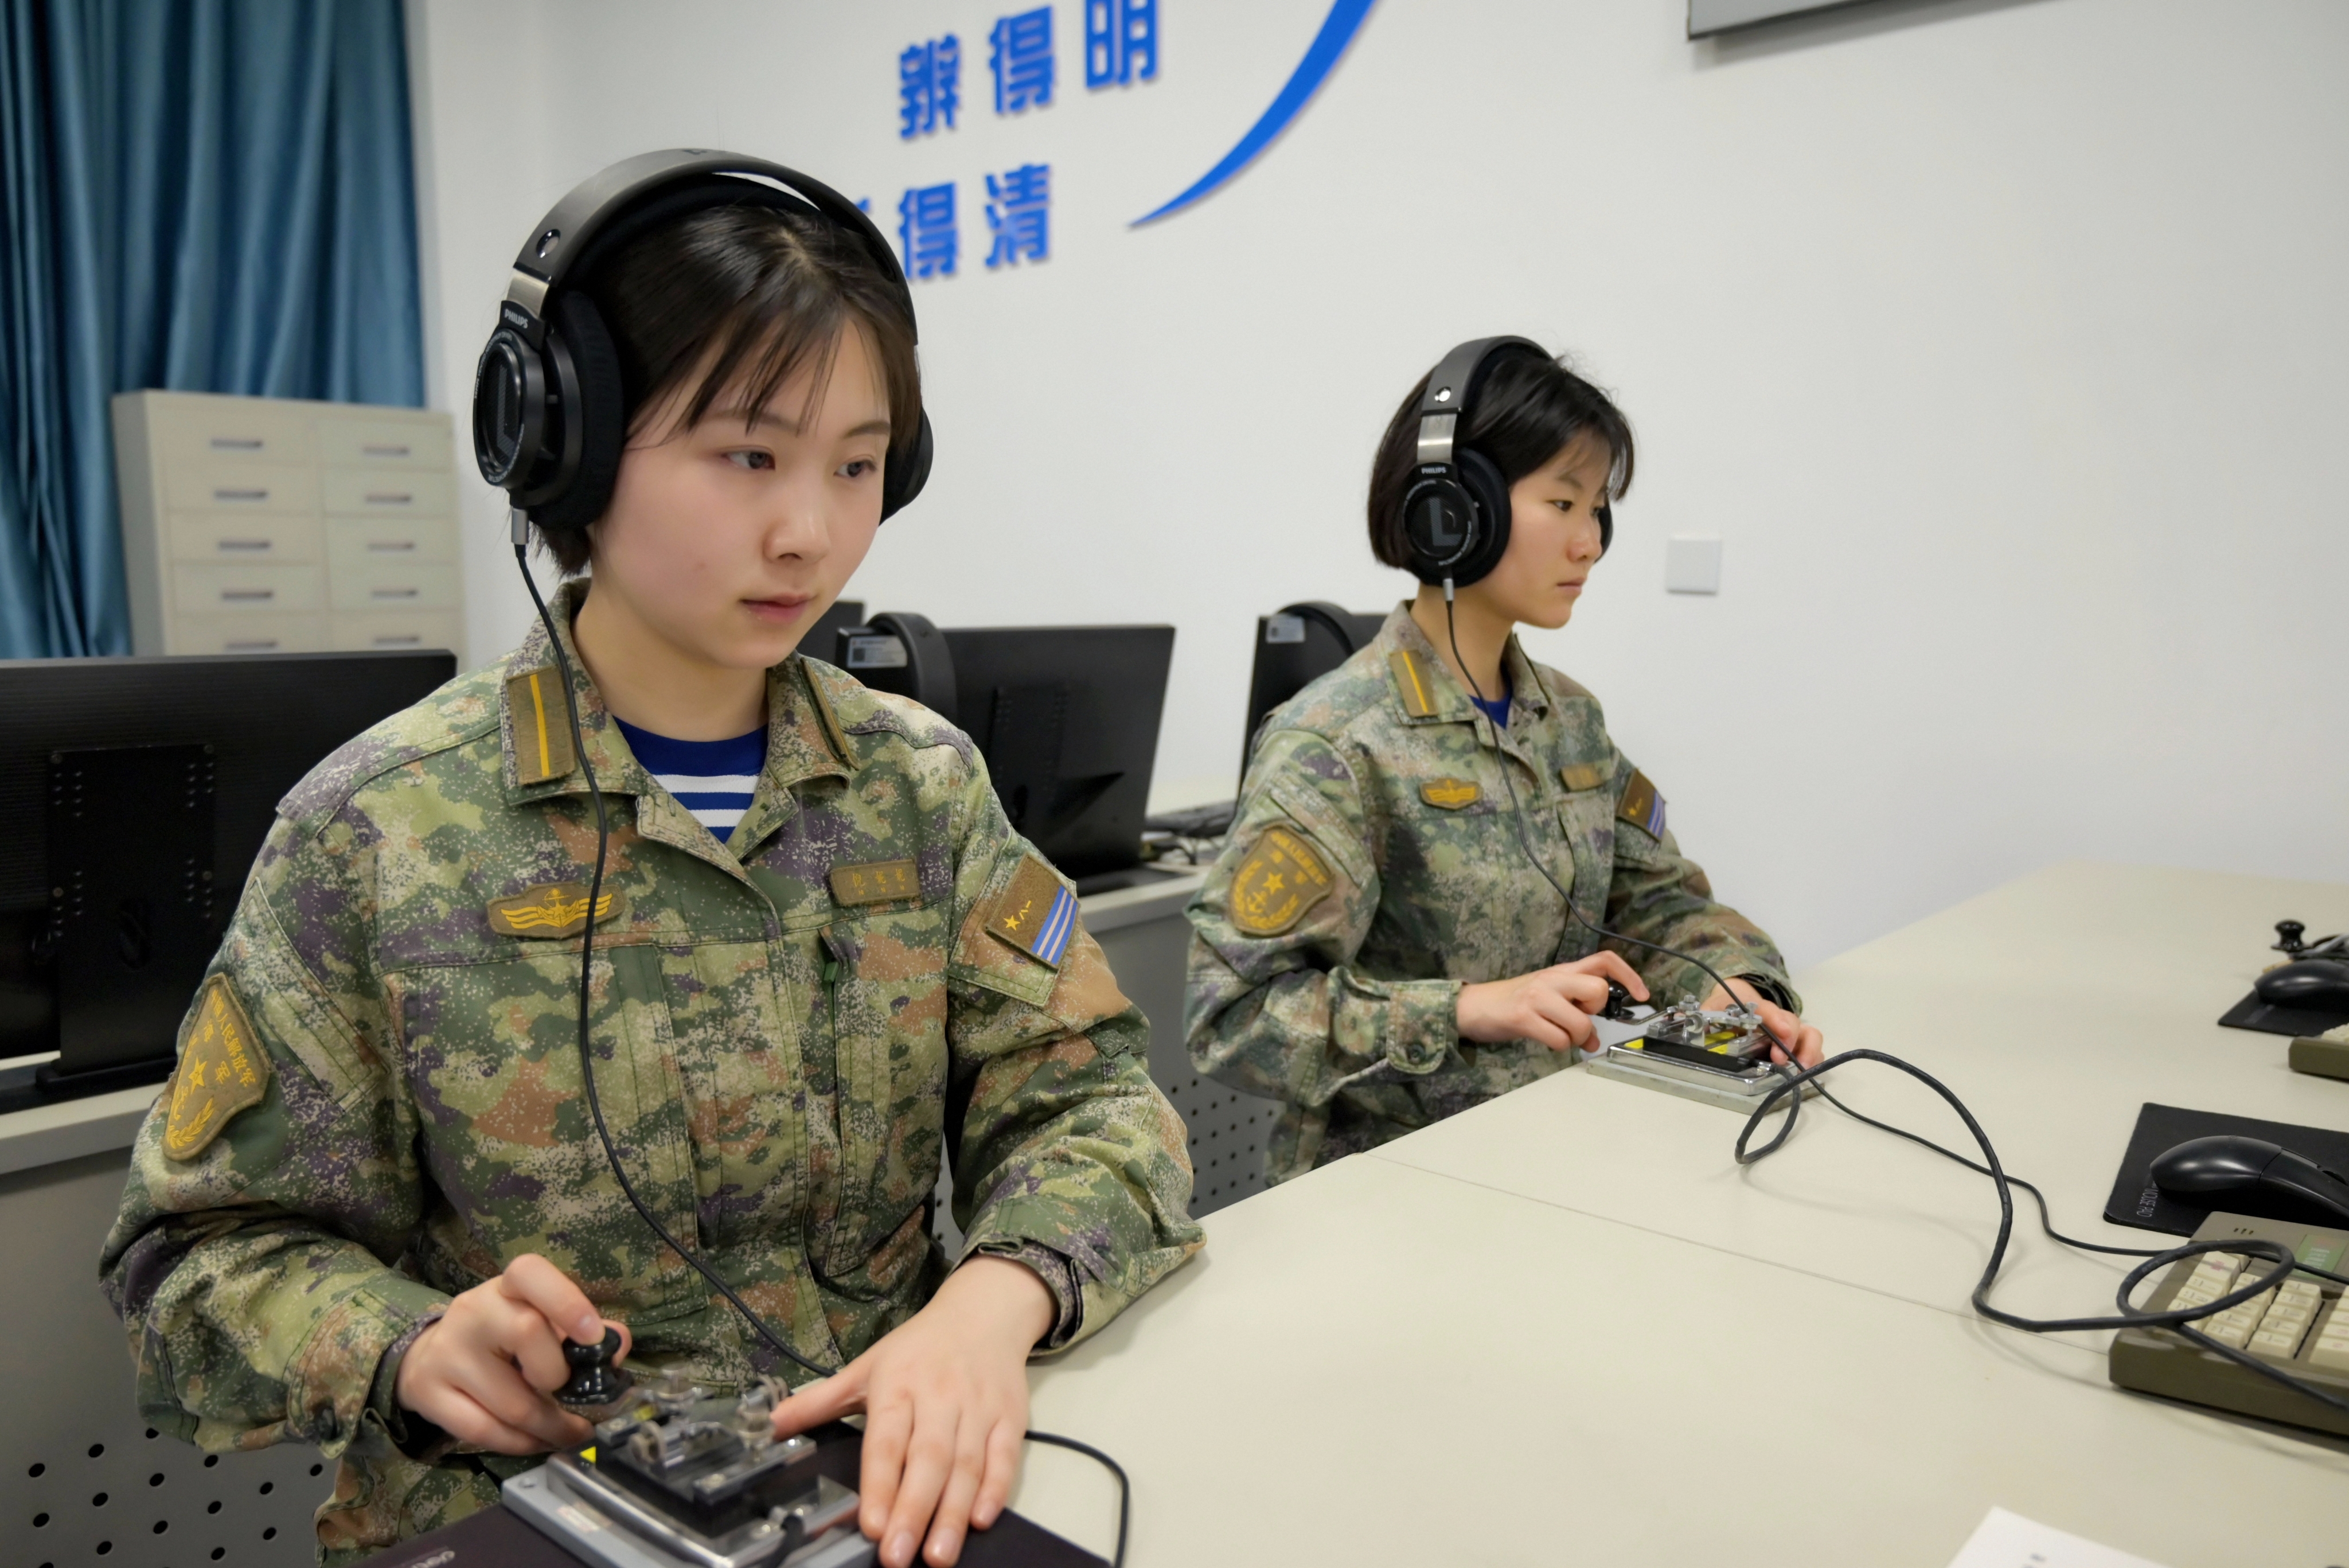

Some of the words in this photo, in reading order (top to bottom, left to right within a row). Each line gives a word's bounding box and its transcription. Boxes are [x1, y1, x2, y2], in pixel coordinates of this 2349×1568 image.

[857, 163, 1049, 279] 得清
[505, 308, 528, 329] PHILIPS
[1421, 466, 1447, 474] PHILIPS
[1428, 496, 1462, 546] L
[210, 989, 256, 1087] 中国人民解放军
[2140, 1188, 2159, 1207] MOUSE
[2137, 1206, 2154, 1217] PAD
